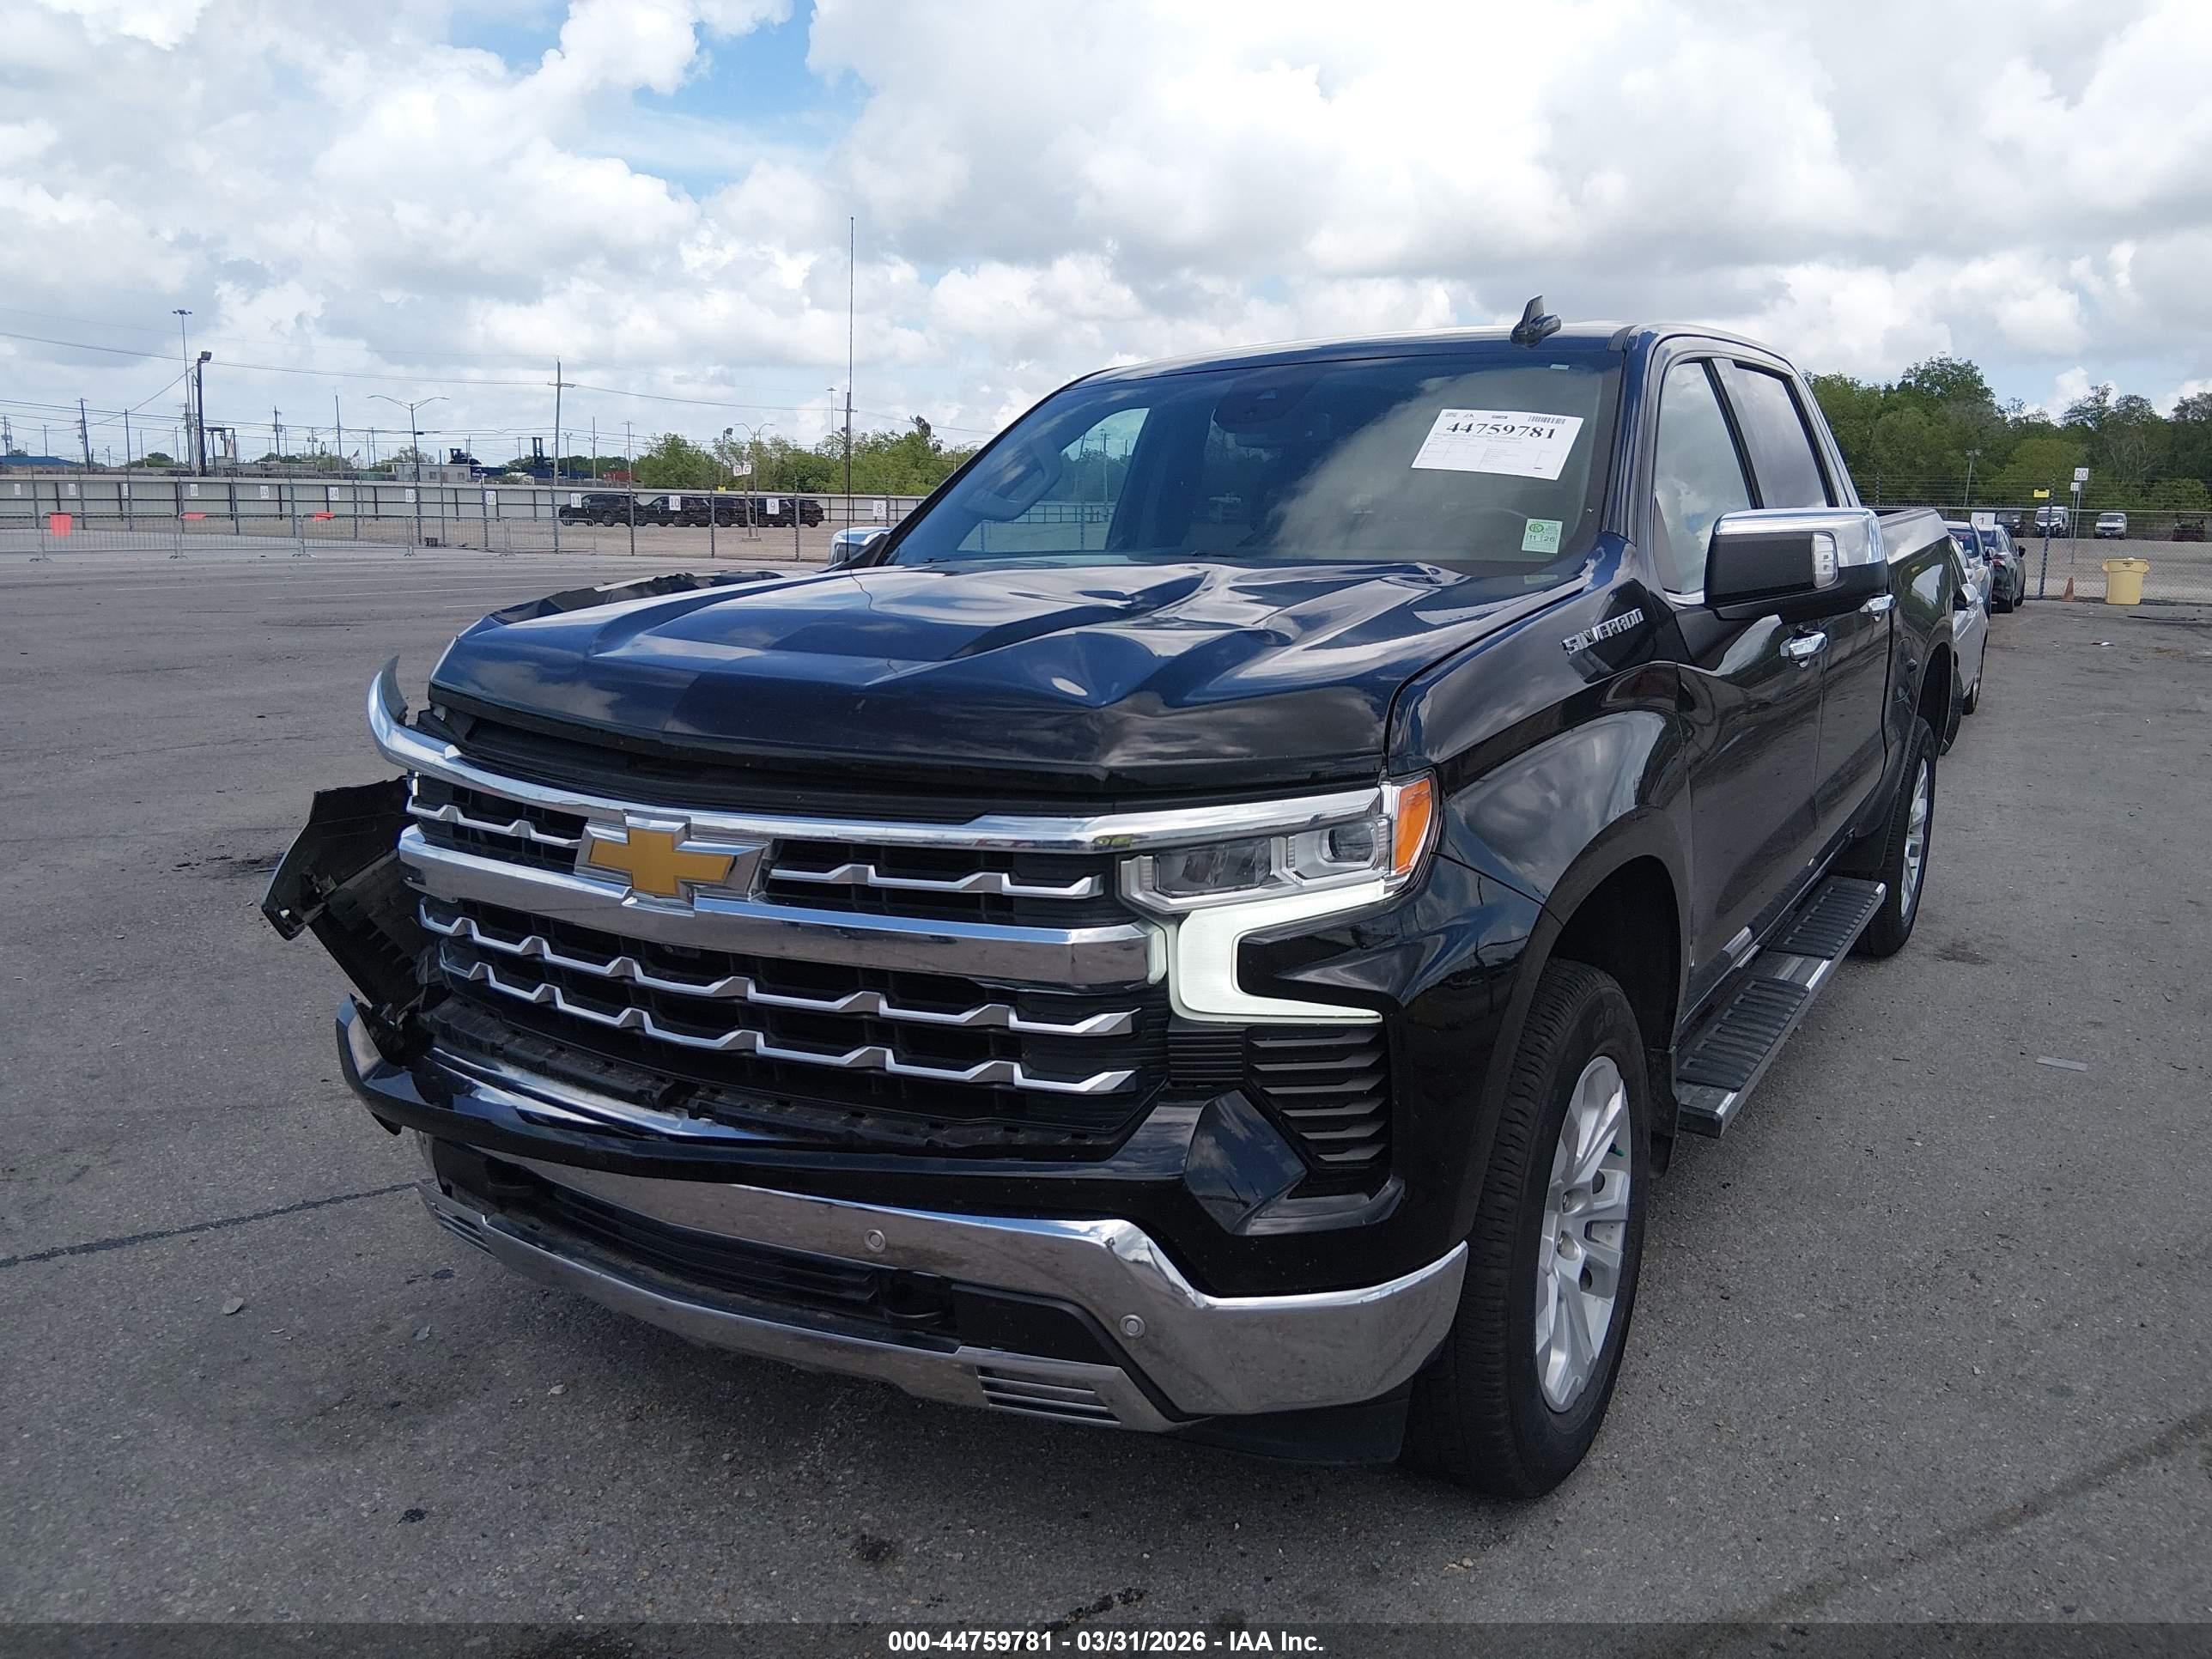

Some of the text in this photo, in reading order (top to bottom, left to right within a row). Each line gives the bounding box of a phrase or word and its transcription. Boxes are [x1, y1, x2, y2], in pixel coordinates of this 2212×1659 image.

[1446, 422, 1557, 440] 44759781
[2075, 470, 2087, 479] 20
[488, 494, 495, 502] 12
[572, 496, 580, 506] 11
[671, 498, 679, 507] 10
[877, 503, 883, 514] 8
[1560, 607, 1644, 655] SILVERADO
